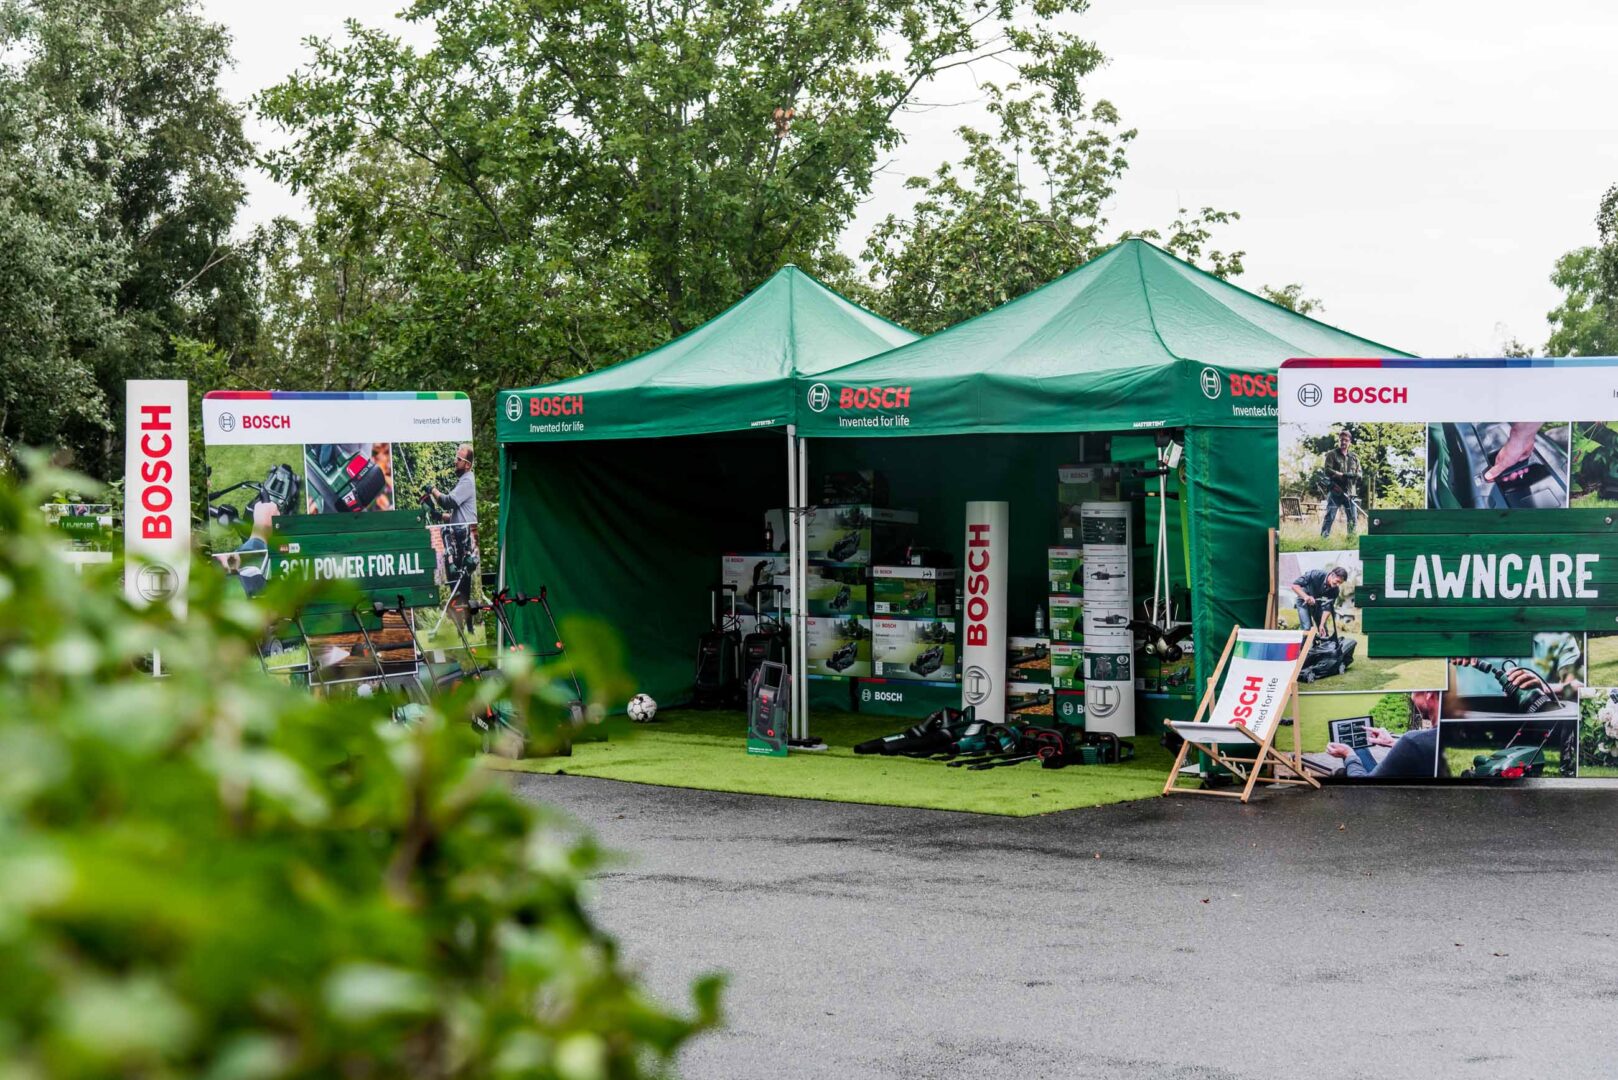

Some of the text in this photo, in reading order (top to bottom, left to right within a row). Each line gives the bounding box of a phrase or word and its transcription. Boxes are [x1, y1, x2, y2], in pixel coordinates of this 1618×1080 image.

[839, 386, 912, 409] BOSCH
[1333, 387, 1408, 404] BOSCH
[530, 395, 584, 416] BOSCH
[1232, 404, 1267, 417] Invented
[242, 415, 291, 429] BOSCH
[413, 416, 462, 425] Invented for life
[530, 421, 584, 432] Invented for life
[838, 414, 910, 427] Invented for life
[141, 405, 173, 539] BOSCH
[314, 556, 365, 580] POWER
[367, 554, 396, 577] FOR
[398, 552, 425, 575] ALL
[1384, 553, 1600, 600] LAWNCARE
[966, 524, 991, 646] BOSCH
[1265, 677, 1279, 693] life
[874, 690, 903, 702] BOSCH
[1261, 695, 1274, 708] for
[1077, 704, 1086, 714] B
